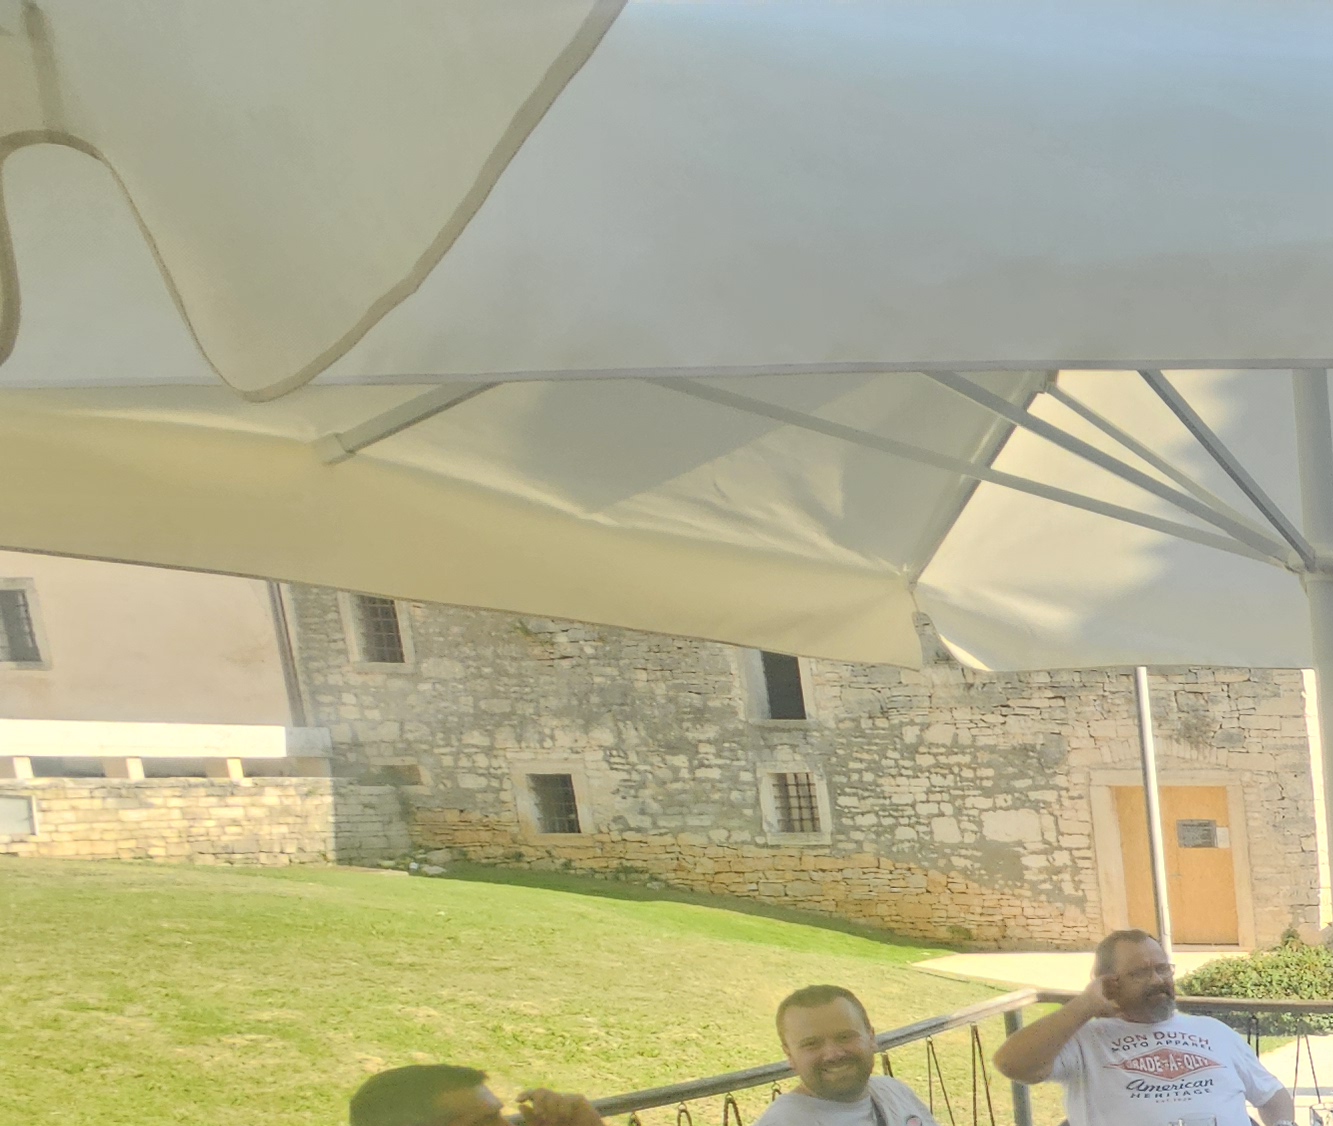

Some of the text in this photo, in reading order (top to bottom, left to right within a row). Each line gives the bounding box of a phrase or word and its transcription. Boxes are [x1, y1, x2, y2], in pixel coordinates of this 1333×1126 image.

[1112, 1031, 1209, 1047] VON DUTCH
[1155, 1040, 1214, 1052] APPAREL
[1125, 1078, 1214, 1093] American
[1130, 1088, 1212, 1099] HERITAGE
